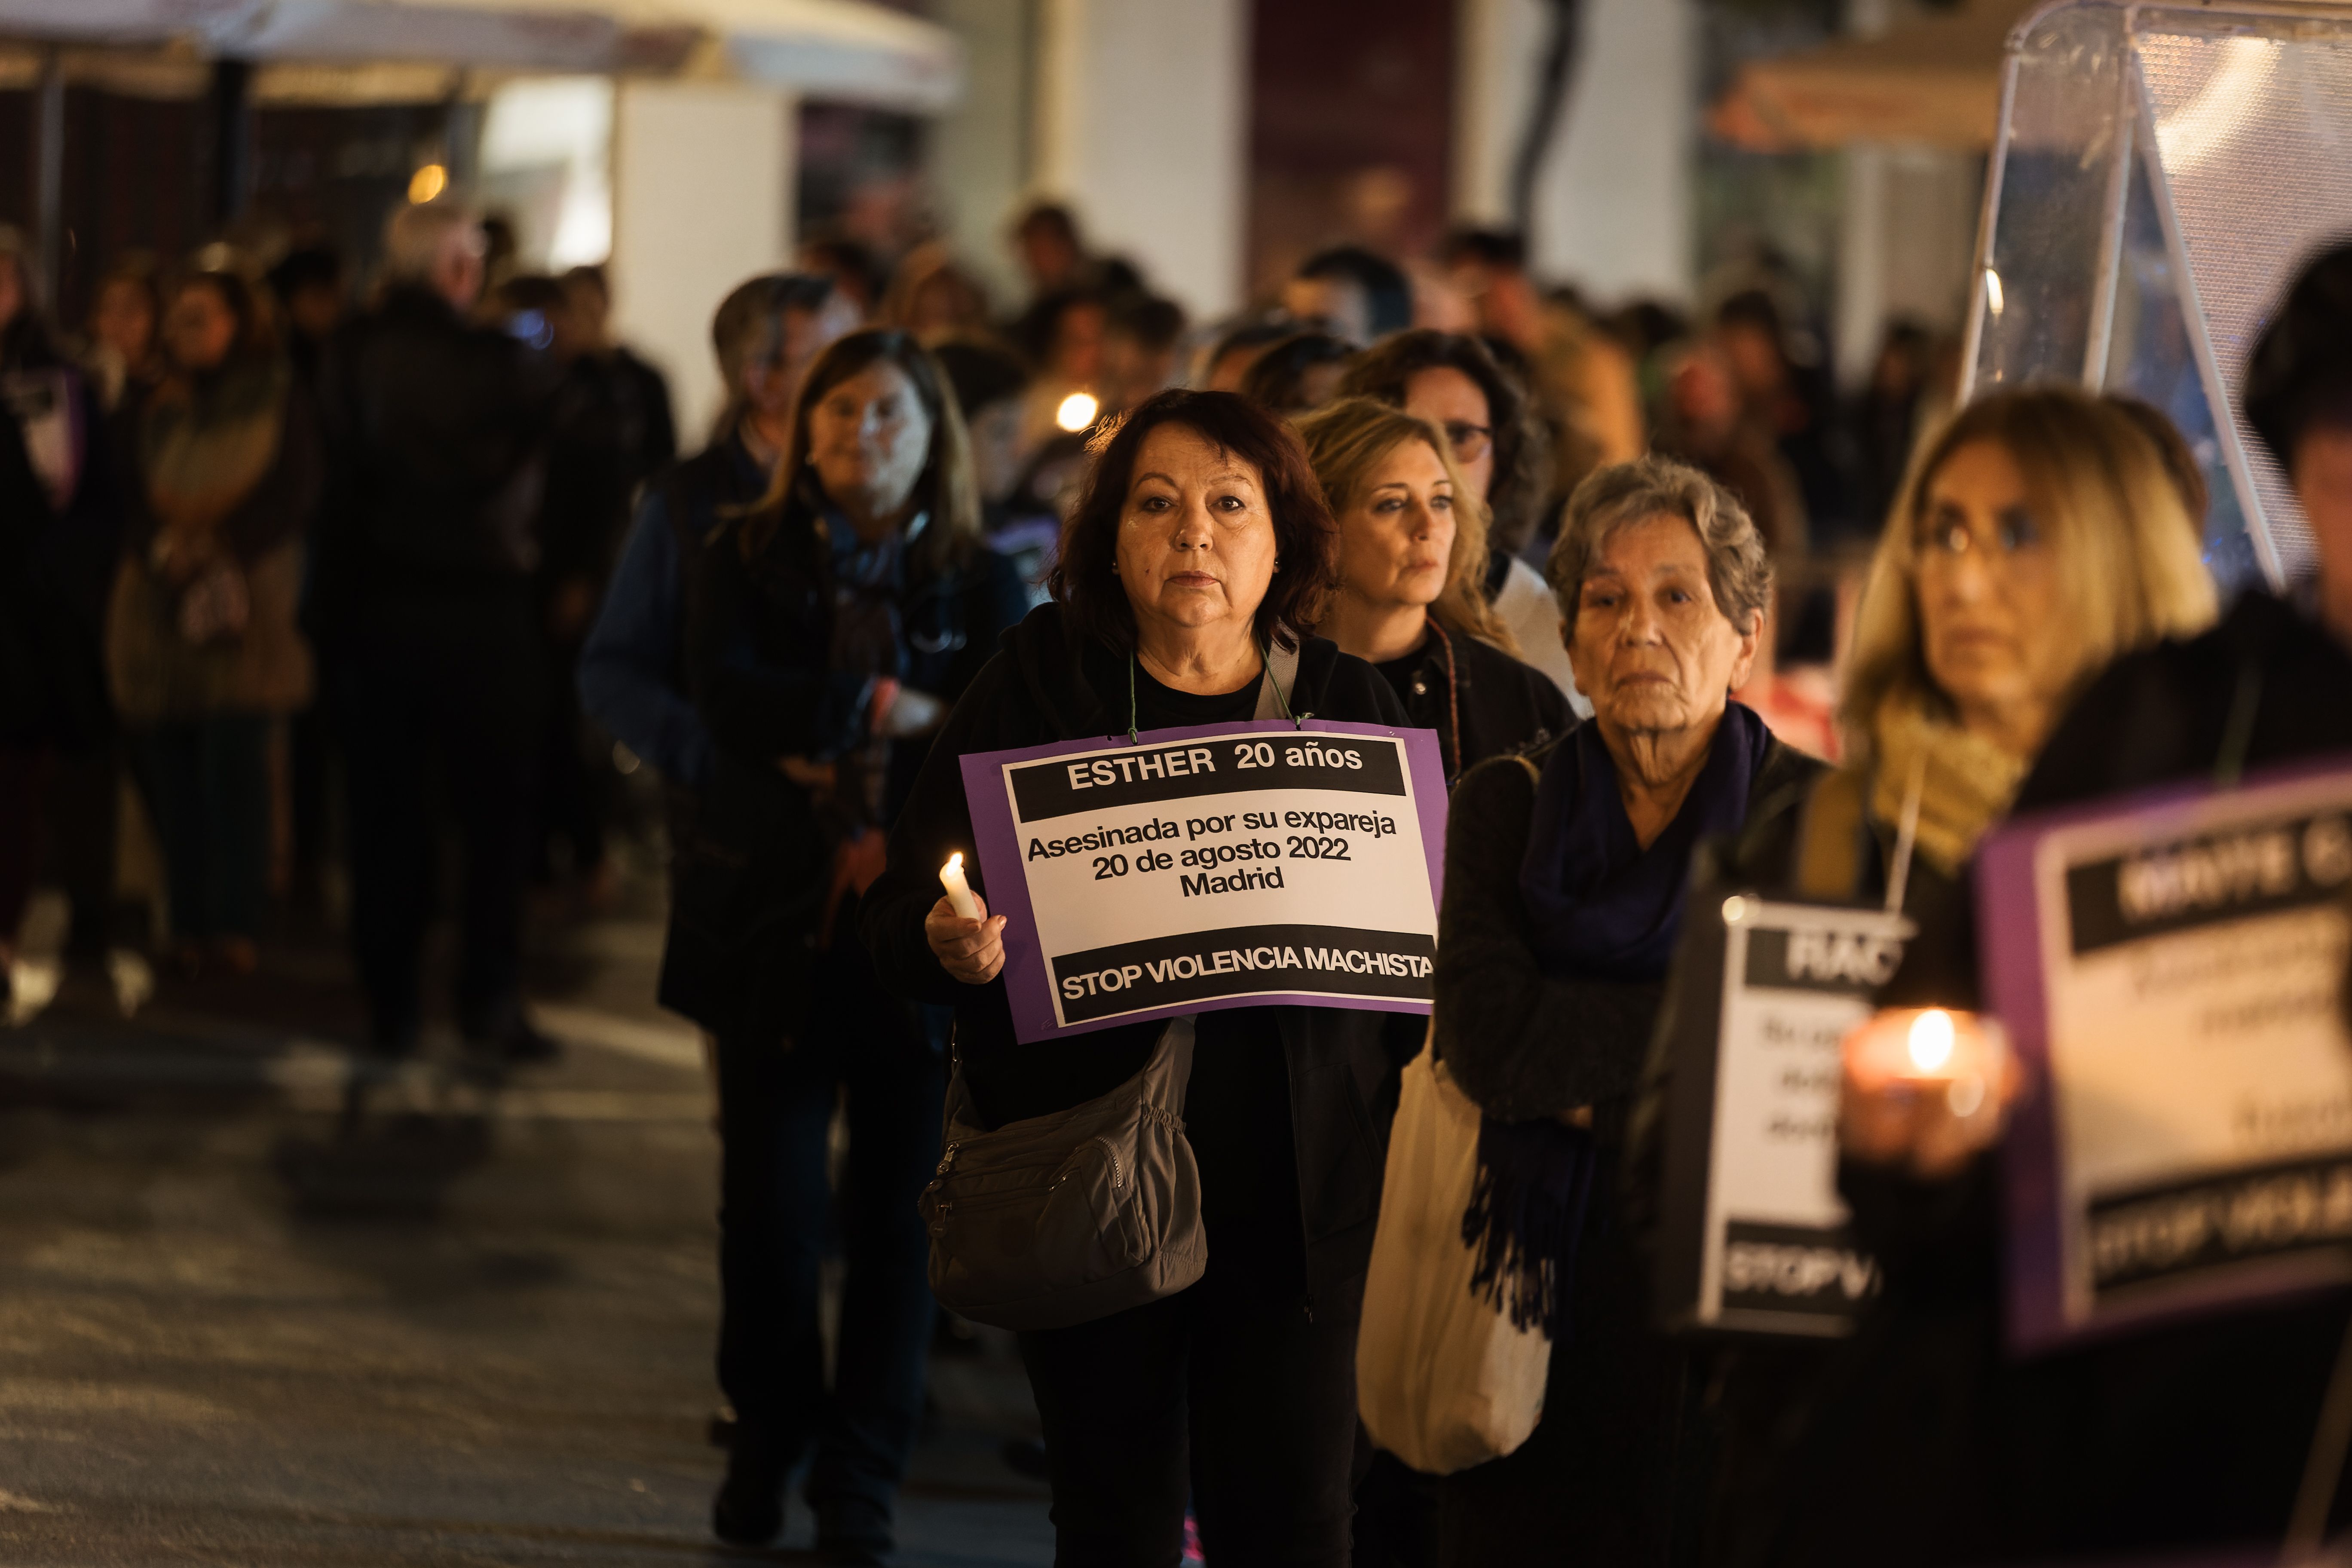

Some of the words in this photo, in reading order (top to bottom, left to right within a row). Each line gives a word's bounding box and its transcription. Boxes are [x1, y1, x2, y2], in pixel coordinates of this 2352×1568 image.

[1067, 748, 1216, 790] ESTHER
[1234, 742, 1275, 769] 20
[1285, 741, 1363, 770] años
[1028, 818, 1180, 862] Asesinada
[1186, 814, 1236, 842] por
[1243, 811, 1278, 830] su
[1284, 810, 1397, 839] expareja
[1092, 854, 1129, 881] 20
[1136, 849, 1173, 873] de
[1180, 839, 1281, 870] agosto
[1286, 836, 1351, 861] 2022
[1179, 866, 1285, 897] Madrid
[1062, 965, 1142, 1000] STOP
[1145, 946, 1303, 983] VIOLENCIA
[1303, 946, 1434, 978] MACHISTA
